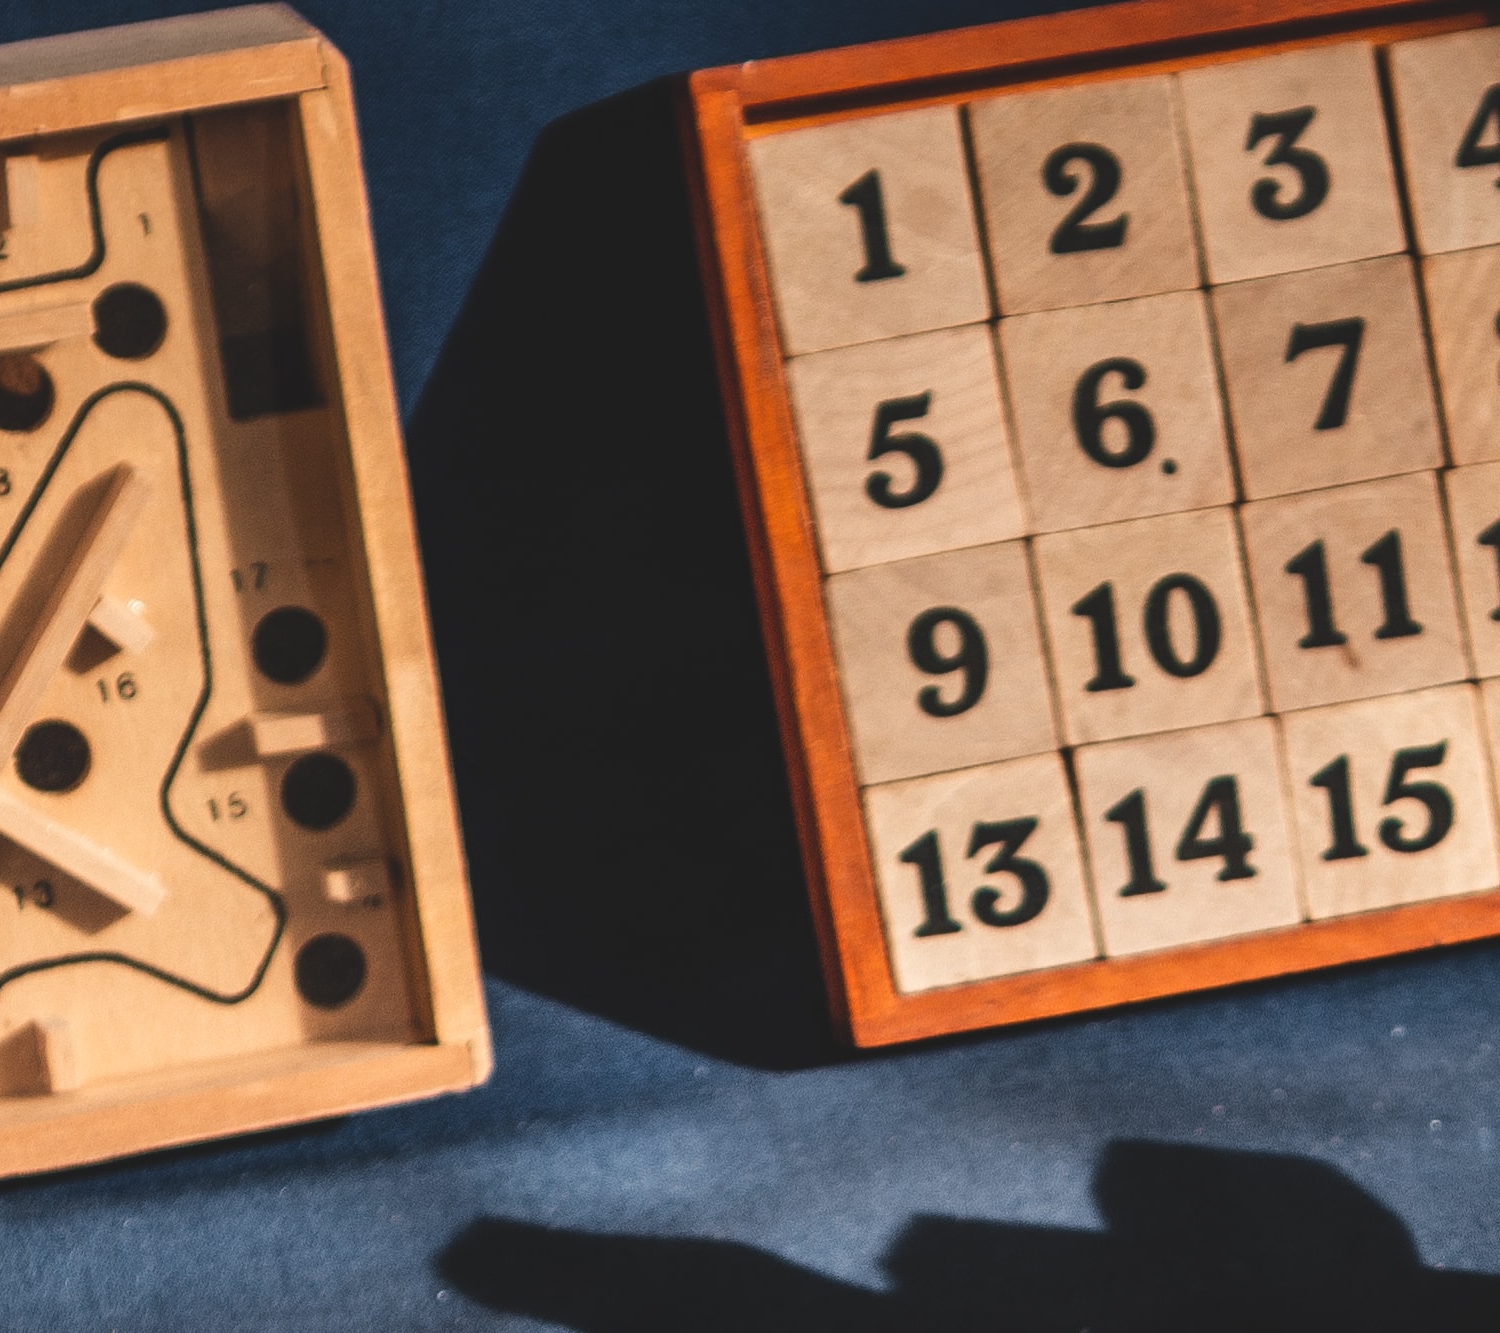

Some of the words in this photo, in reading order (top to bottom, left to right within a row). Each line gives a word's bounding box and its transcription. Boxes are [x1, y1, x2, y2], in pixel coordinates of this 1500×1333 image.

[839, 170, 906, 284] 1
[1041, 142, 1129, 256] 2
[1246, 106, 1330, 222] 3
[138, 212, 153, 235] 1
[866, 393, 944, 510] 5
[1284, 316, 1366, 432] 7
[231, 561, 273, 594] 17
[907, 607, 989, 718] 9
[1072, 573, 1222, 693] 10
[1285, 530, 1423, 650] 11
[95, 671, 139, 702] 16
[207, 791, 248, 823] 15
[901, 818, 1050, 938] 13
[1106, 776, 1256, 897] 14
[1311, 743, 1453, 861] 15
[14, 879, 55, 909] 13
